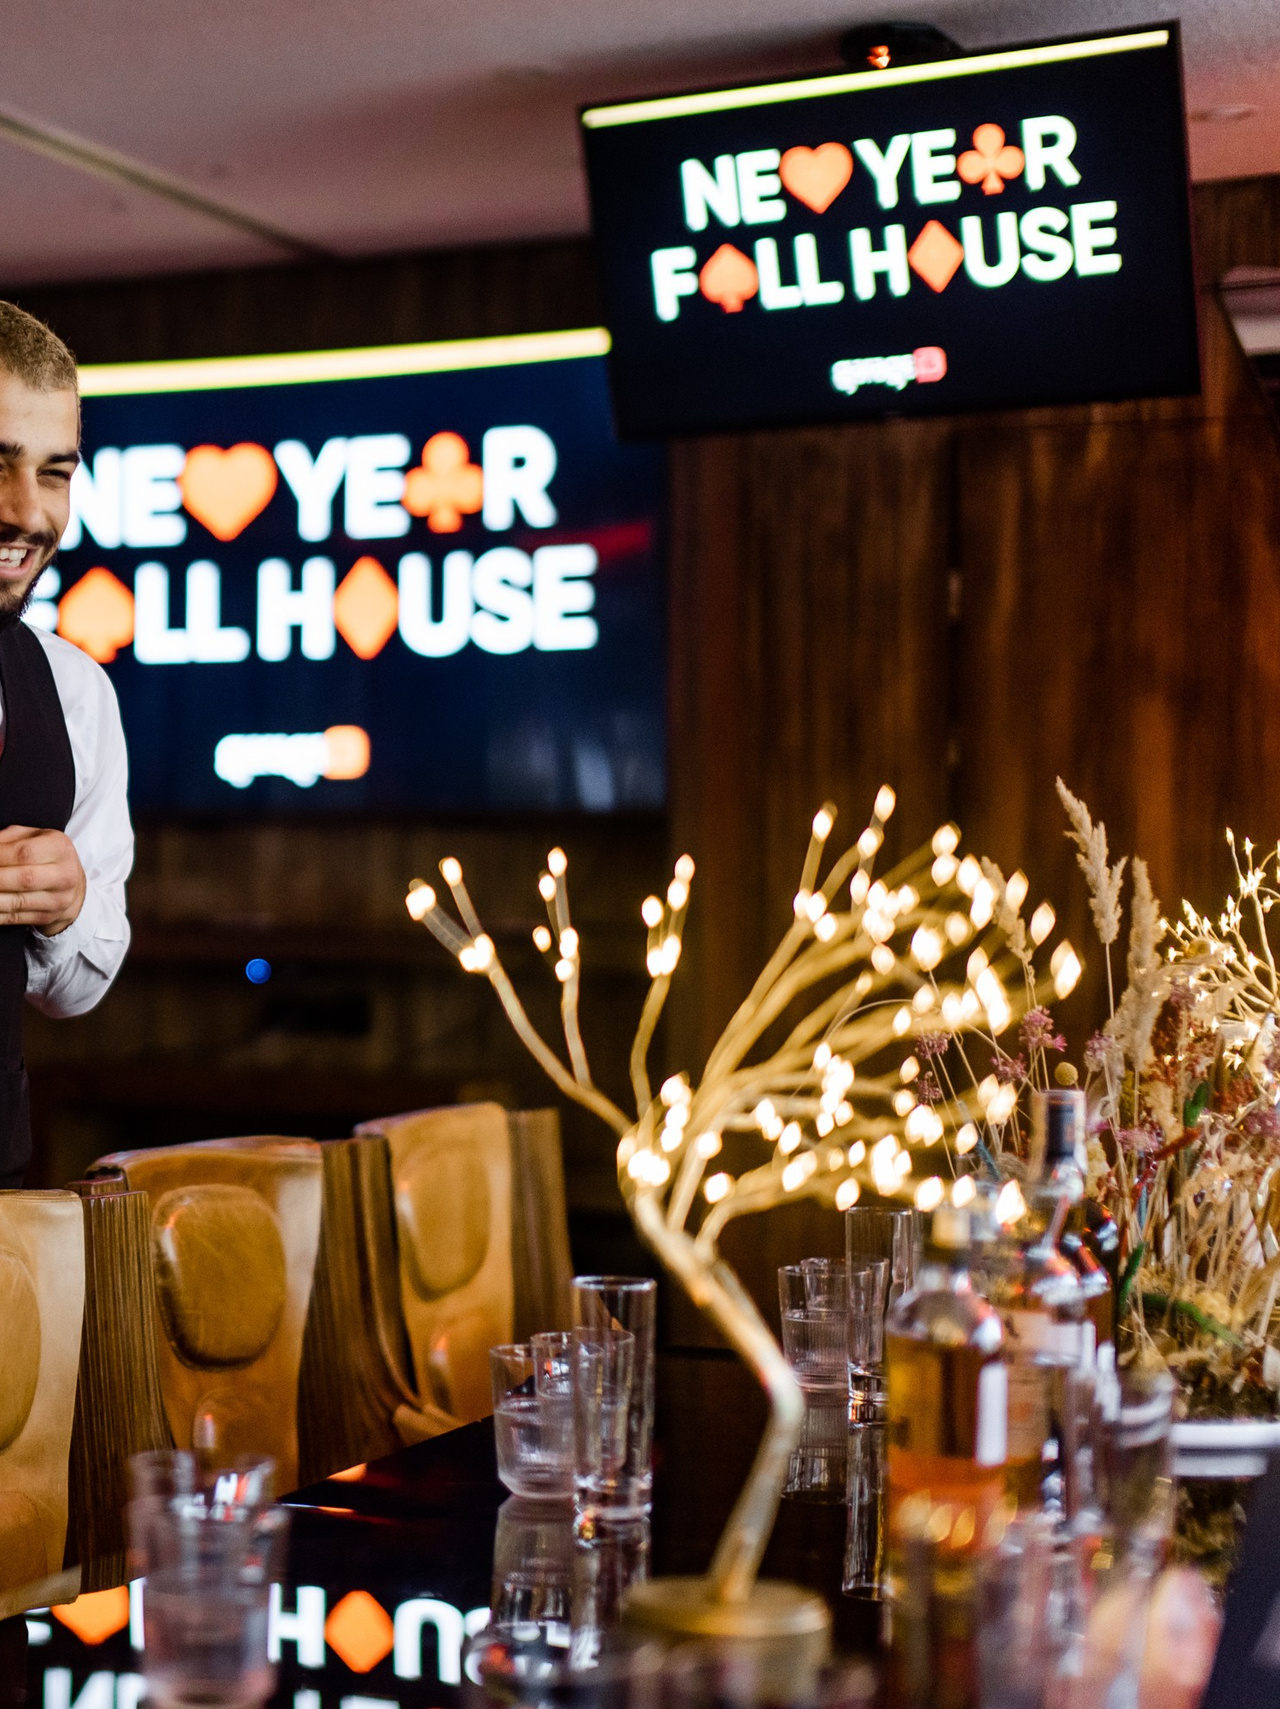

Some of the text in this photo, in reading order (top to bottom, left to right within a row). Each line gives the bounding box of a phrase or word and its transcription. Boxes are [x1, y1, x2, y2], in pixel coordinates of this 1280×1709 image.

[681, 114, 1081, 232] NE YER
[650, 200, 1122, 322] FLL HUSE
[273, 424, 557, 543] YER
[256, 543, 598, 662] HUSE
